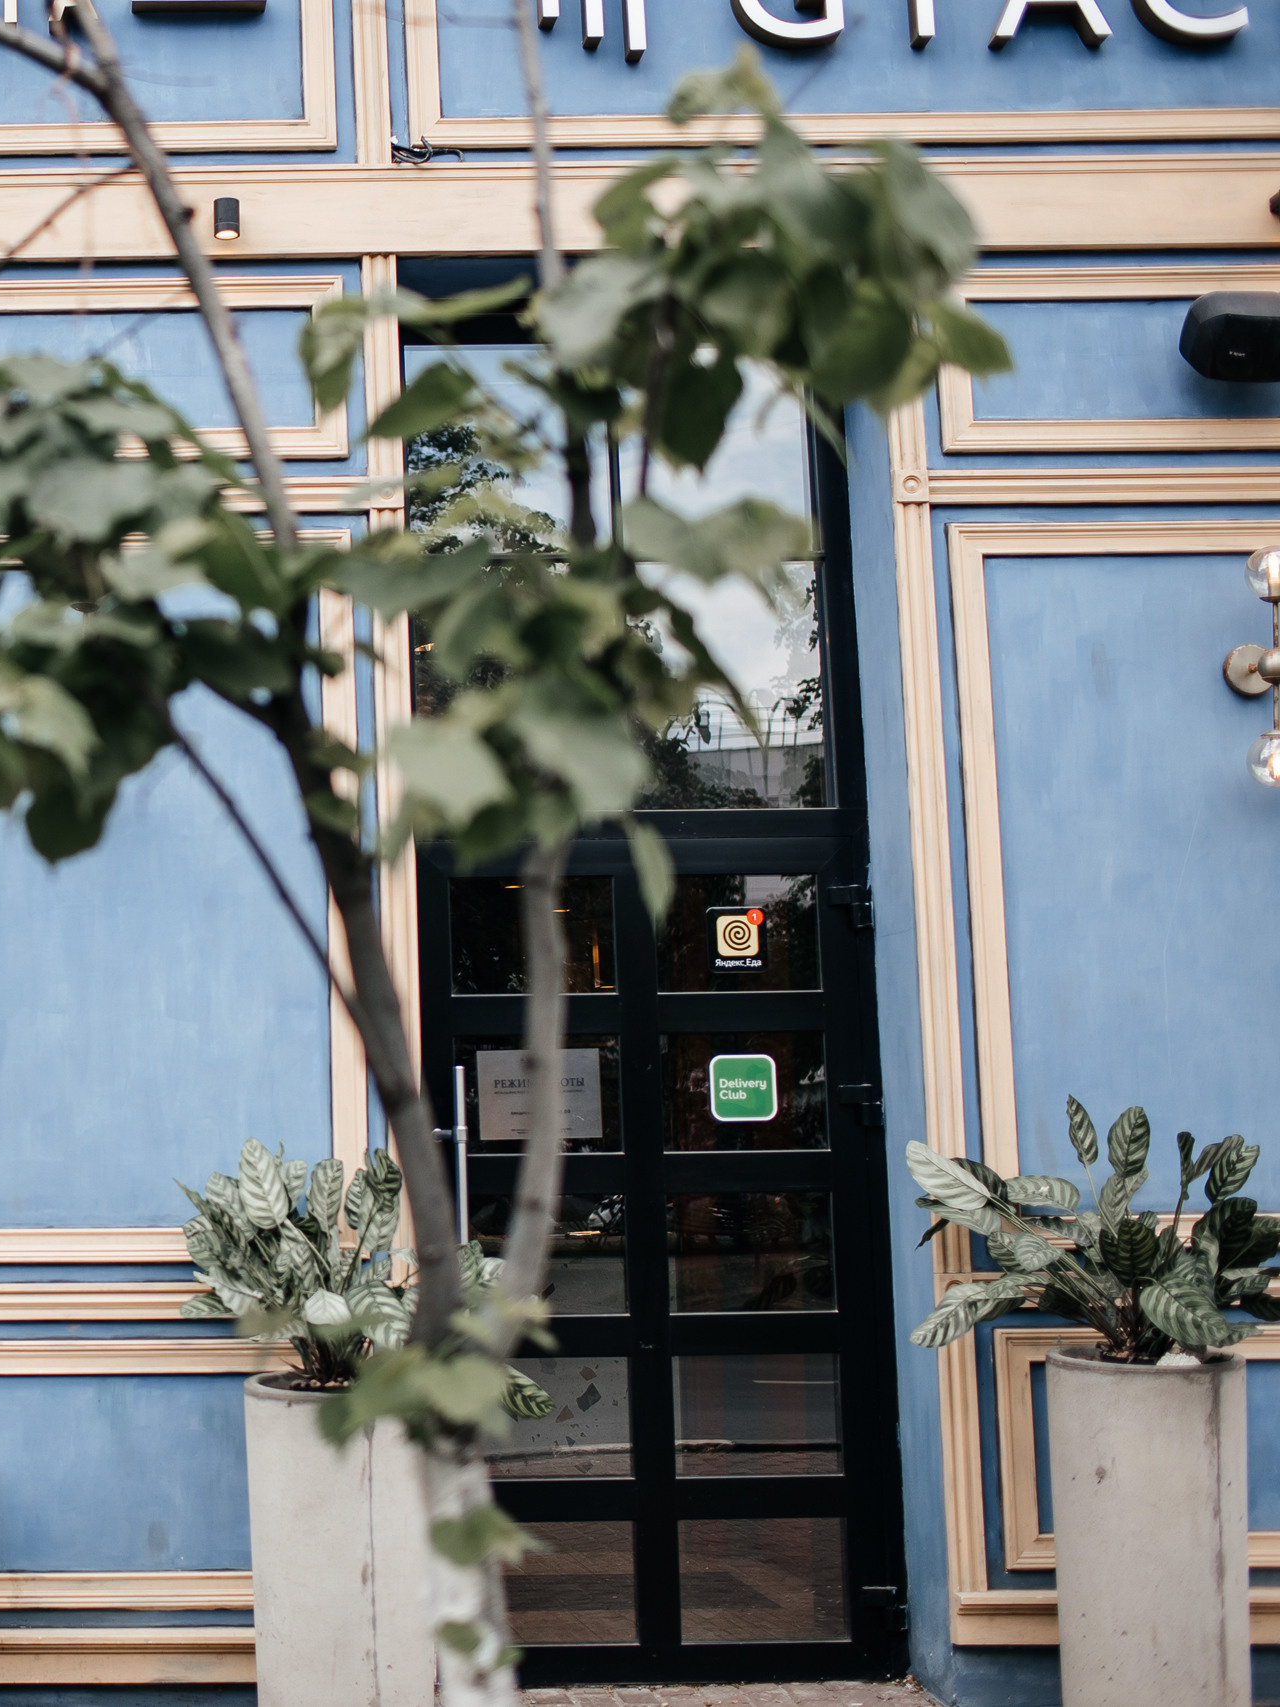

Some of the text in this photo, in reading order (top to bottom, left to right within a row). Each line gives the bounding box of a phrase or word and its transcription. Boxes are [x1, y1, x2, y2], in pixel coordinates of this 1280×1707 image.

[494, 1079, 531, 1089] РЕЖИ
[719, 1078, 767, 1090] Delivery
[719, 1090, 747, 1100] Club
